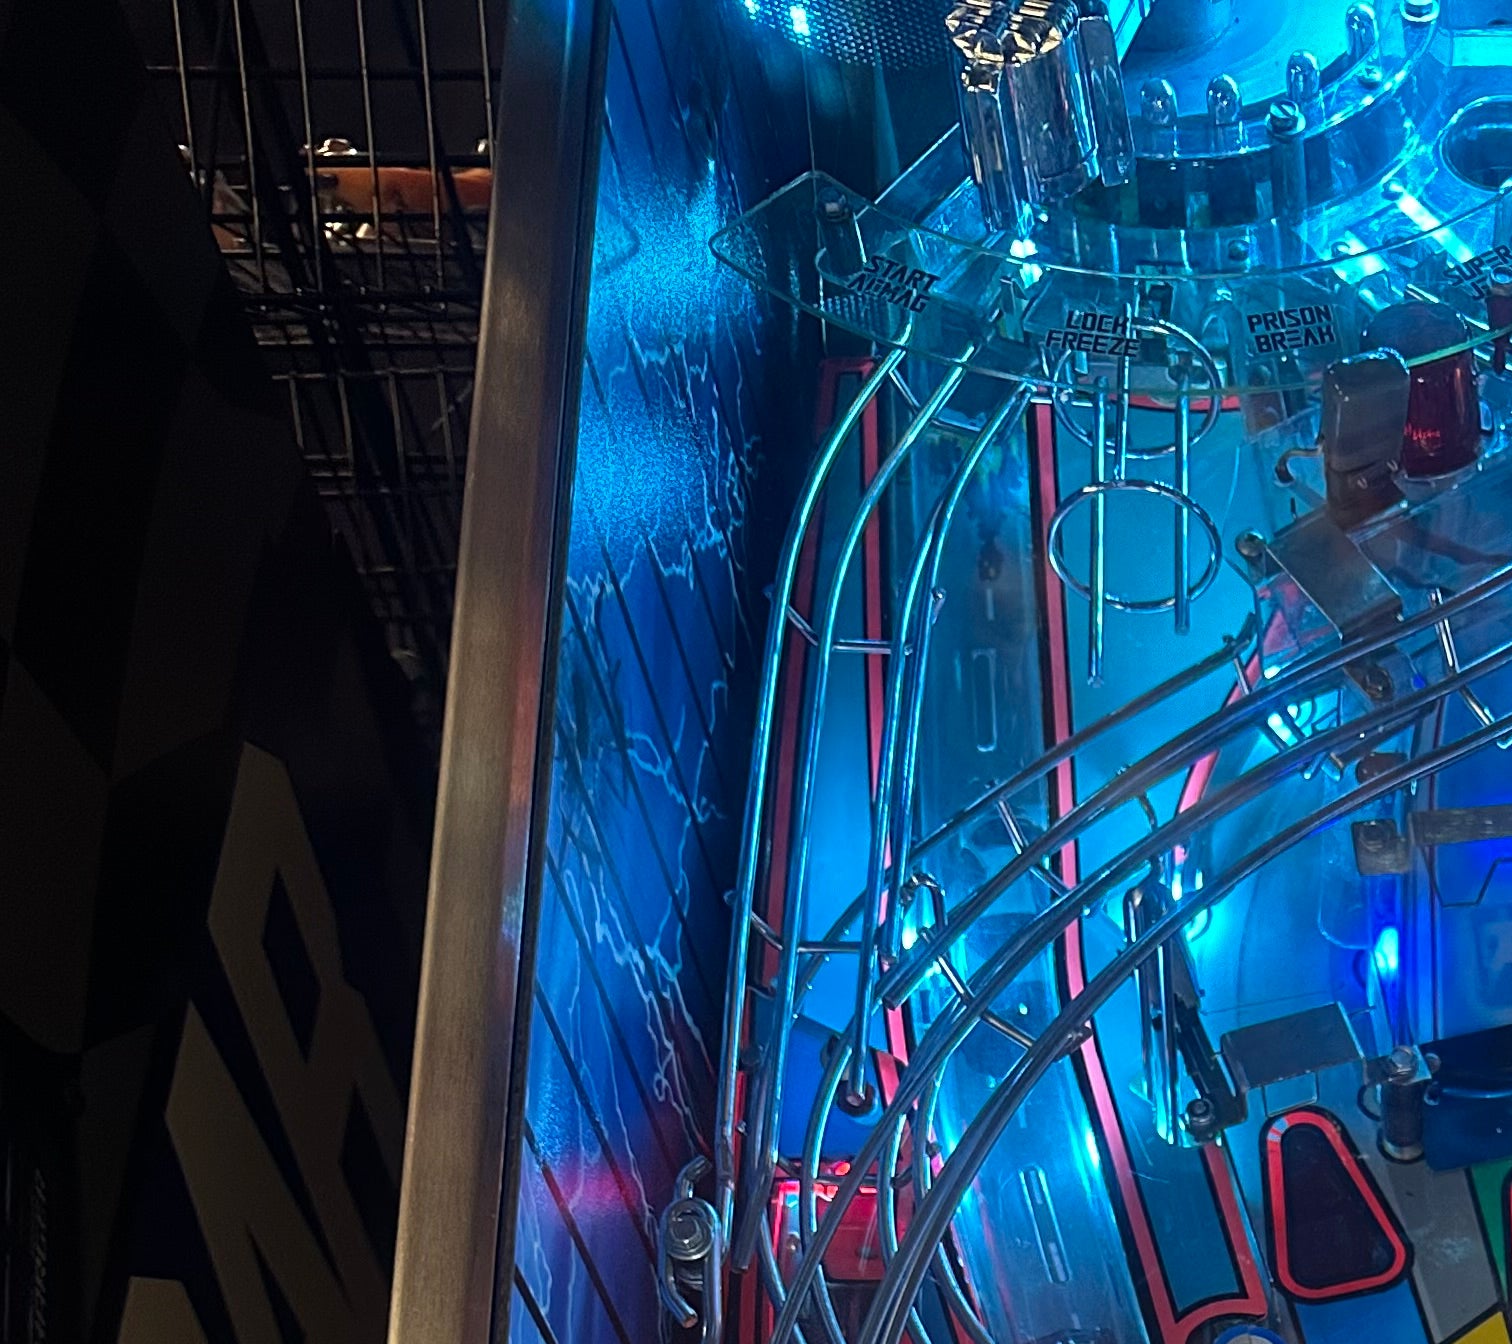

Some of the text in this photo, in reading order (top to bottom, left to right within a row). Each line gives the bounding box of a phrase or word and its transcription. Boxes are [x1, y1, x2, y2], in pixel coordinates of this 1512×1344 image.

[864, 255, 941, 292] START
[1065, 310, 1131, 335] LOCK
[1248, 305, 1332, 329] PRISON
[1046, 328, 1140, 358] FREEZE
[1255, 324, 1336, 352] BREAK
